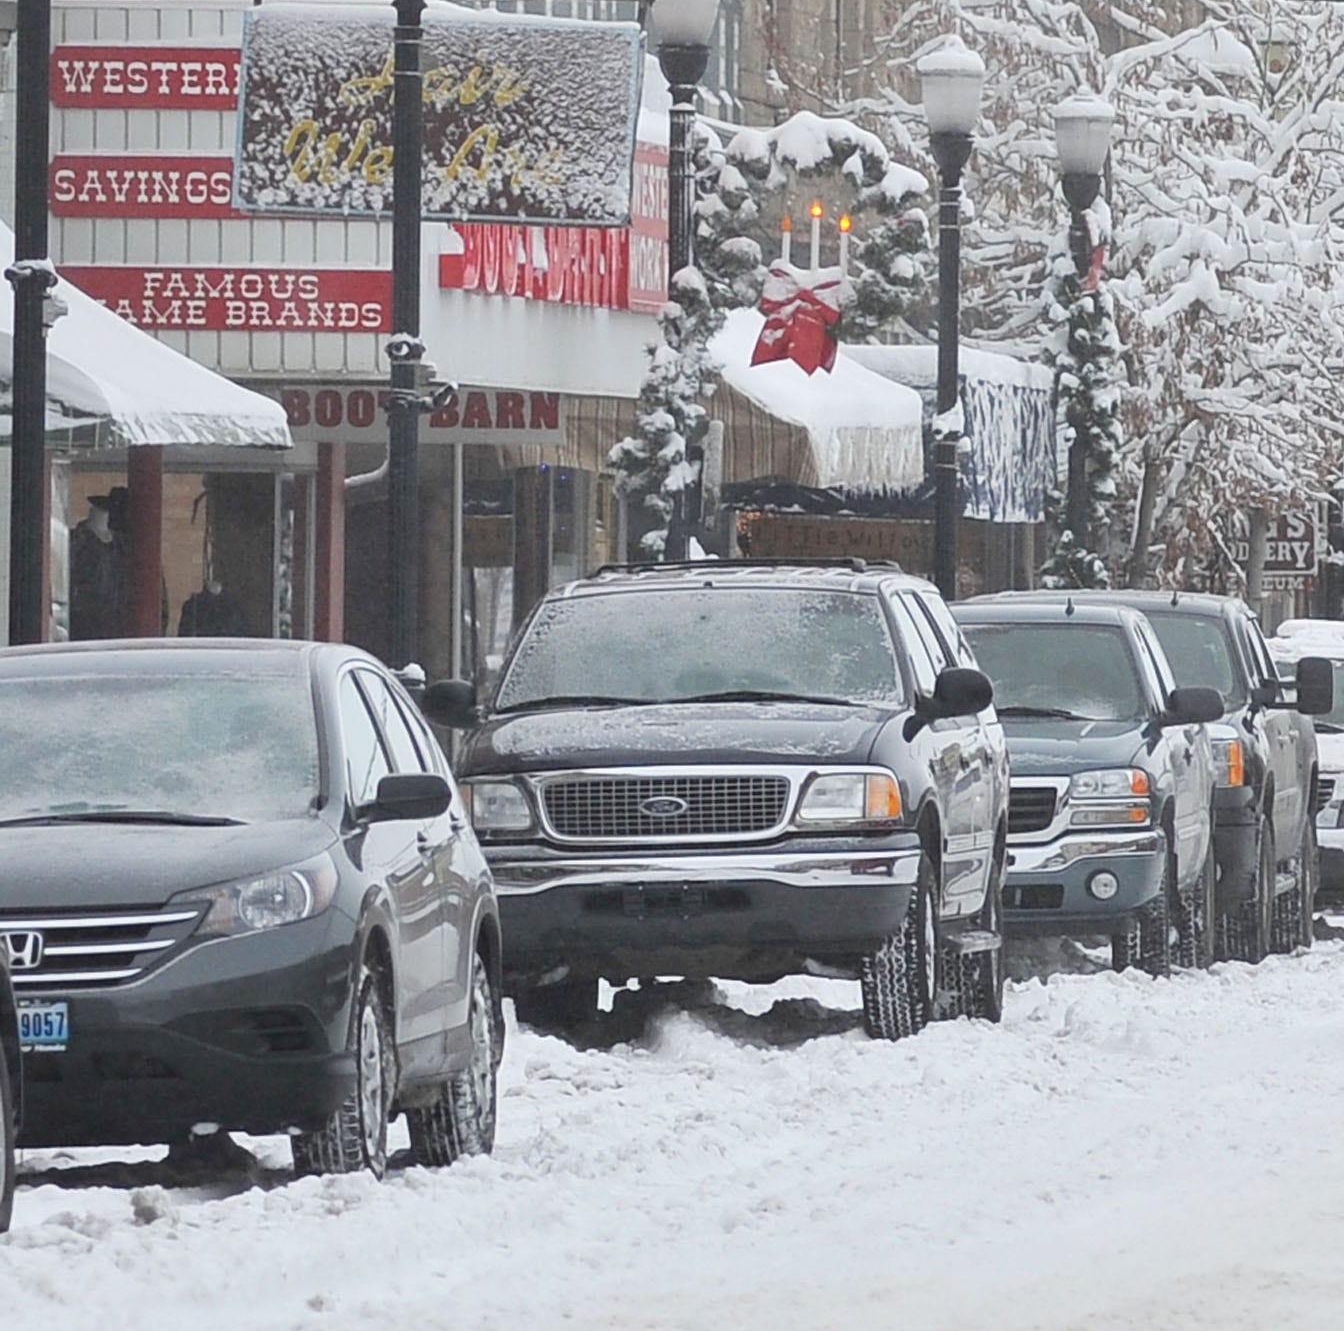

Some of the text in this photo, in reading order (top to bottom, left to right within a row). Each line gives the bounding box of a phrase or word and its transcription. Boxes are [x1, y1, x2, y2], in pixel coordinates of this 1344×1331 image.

[54, 169, 232, 204] SAVINGS
[143, 262, 320, 300] FAMOUS
[95, 289, 383, 328] AME BRANDS
[429, 391, 561, 430] BARN
[21, 1011, 65, 1038] 9057
